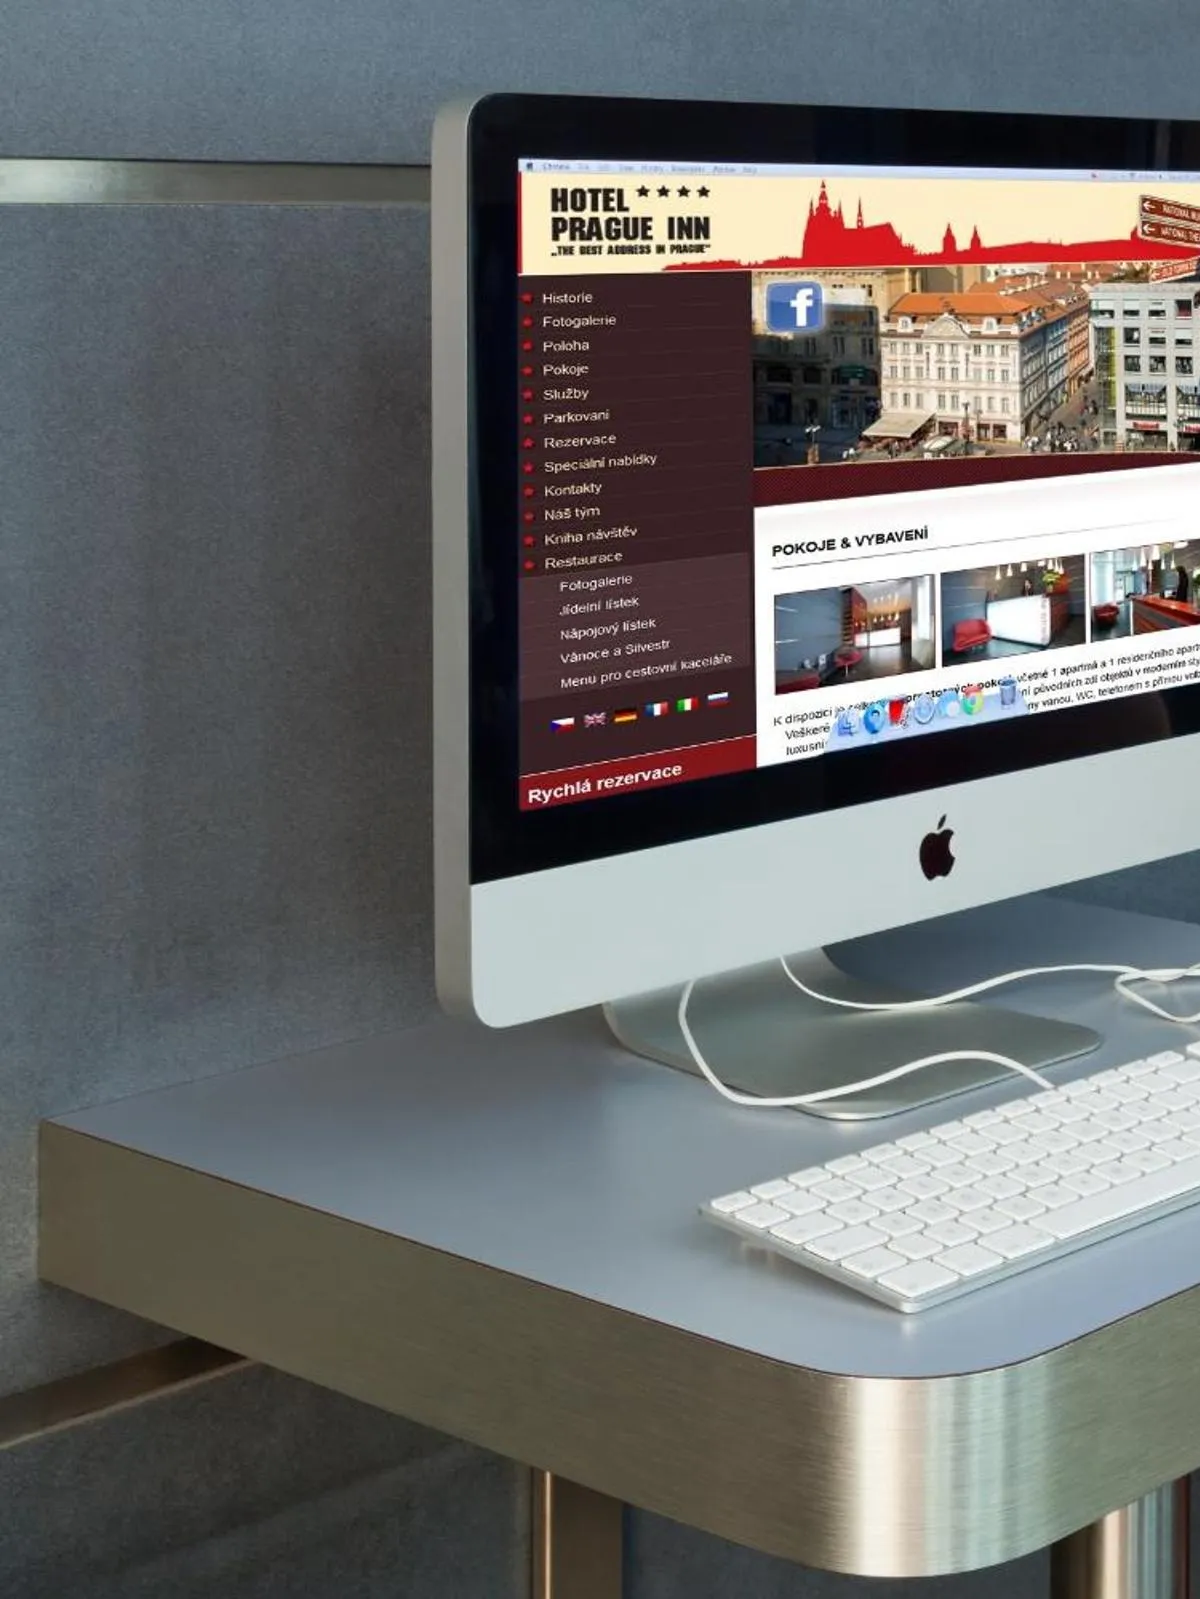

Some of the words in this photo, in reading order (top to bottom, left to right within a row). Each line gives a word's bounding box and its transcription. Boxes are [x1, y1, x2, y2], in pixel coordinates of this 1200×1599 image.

[551, 188, 630, 213] HOTEL
[551, 216, 654, 242] PRAGUE
[667, 216, 711, 241] INN
[579, 244, 603, 255] BEST
[607, 244, 652, 255] ADDRESS
[656, 244, 666, 254] IN
[543, 291, 593, 304] Historie
[543, 314, 617, 329] Fotogalerie
[543, 339, 590, 352] Poloha
[543, 363, 589, 377] Pokoje
[543, 387, 590, 401] Služby
[544, 433, 617, 449] Rezervace
[544, 482, 602, 497] Kontakty
[575, 505, 601, 520] tým
[545, 531, 584, 546] Kniha
[772, 538, 836, 557] POKOJE
[840, 536, 852, 549] &
[855, 525, 929, 547] VYBAVENÍ
[545, 551, 624, 569] Restaurace
[559, 575, 633, 593] Fotogalerie
[560, 621, 620, 640] Nápojový
[560, 646, 610, 664] Vánoce
[613, 646, 622, 657] a
[625, 638, 671, 655] Silvestr
[560, 674, 597, 688] Menu
[600, 671, 622, 685] pro
[773, 717, 783, 726] K
[527, 777, 593, 804] Rychlá
[596, 764, 684, 790] rezervace
